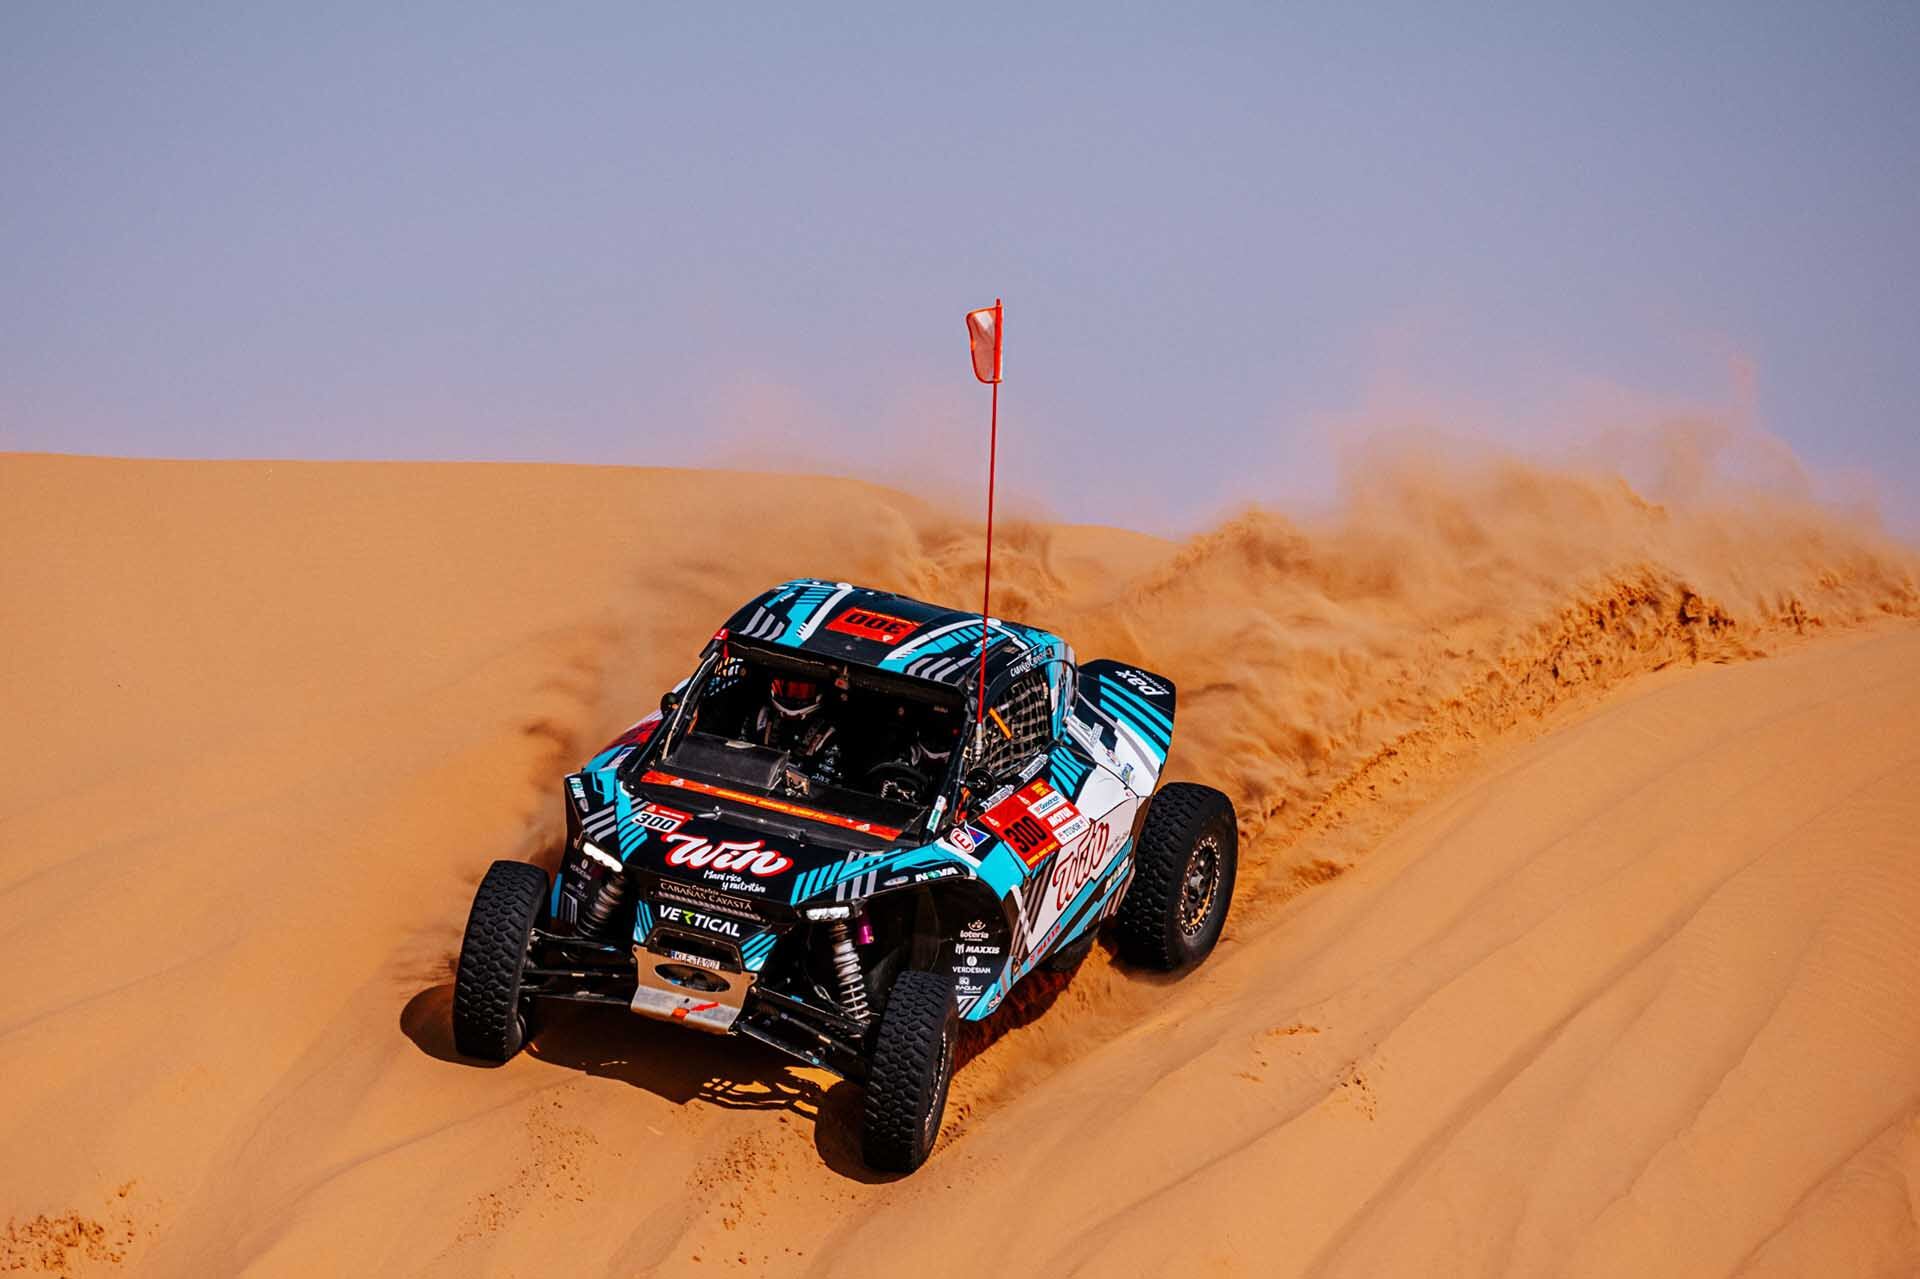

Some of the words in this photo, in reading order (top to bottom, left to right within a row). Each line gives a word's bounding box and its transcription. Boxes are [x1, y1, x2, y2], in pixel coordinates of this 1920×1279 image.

[844, 613, 907, 635] 300
[1114, 669, 1165, 695] pax
[635, 813, 677, 831] 300
[953, 832, 972, 850] E
[1003, 815, 1048, 854] 300
[661, 832, 794, 877] Win
[1052, 817, 1110, 911] Win
[914, 866, 959, 882] NOVA
[660, 882, 707, 900] CABAÑAS
[721, 881, 730, 892] y
[659, 904, 741, 937] VERTICAL
[965, 945, 1001, 955] MAXXIS
[952, 965, 991, 974] VERDESIAN
